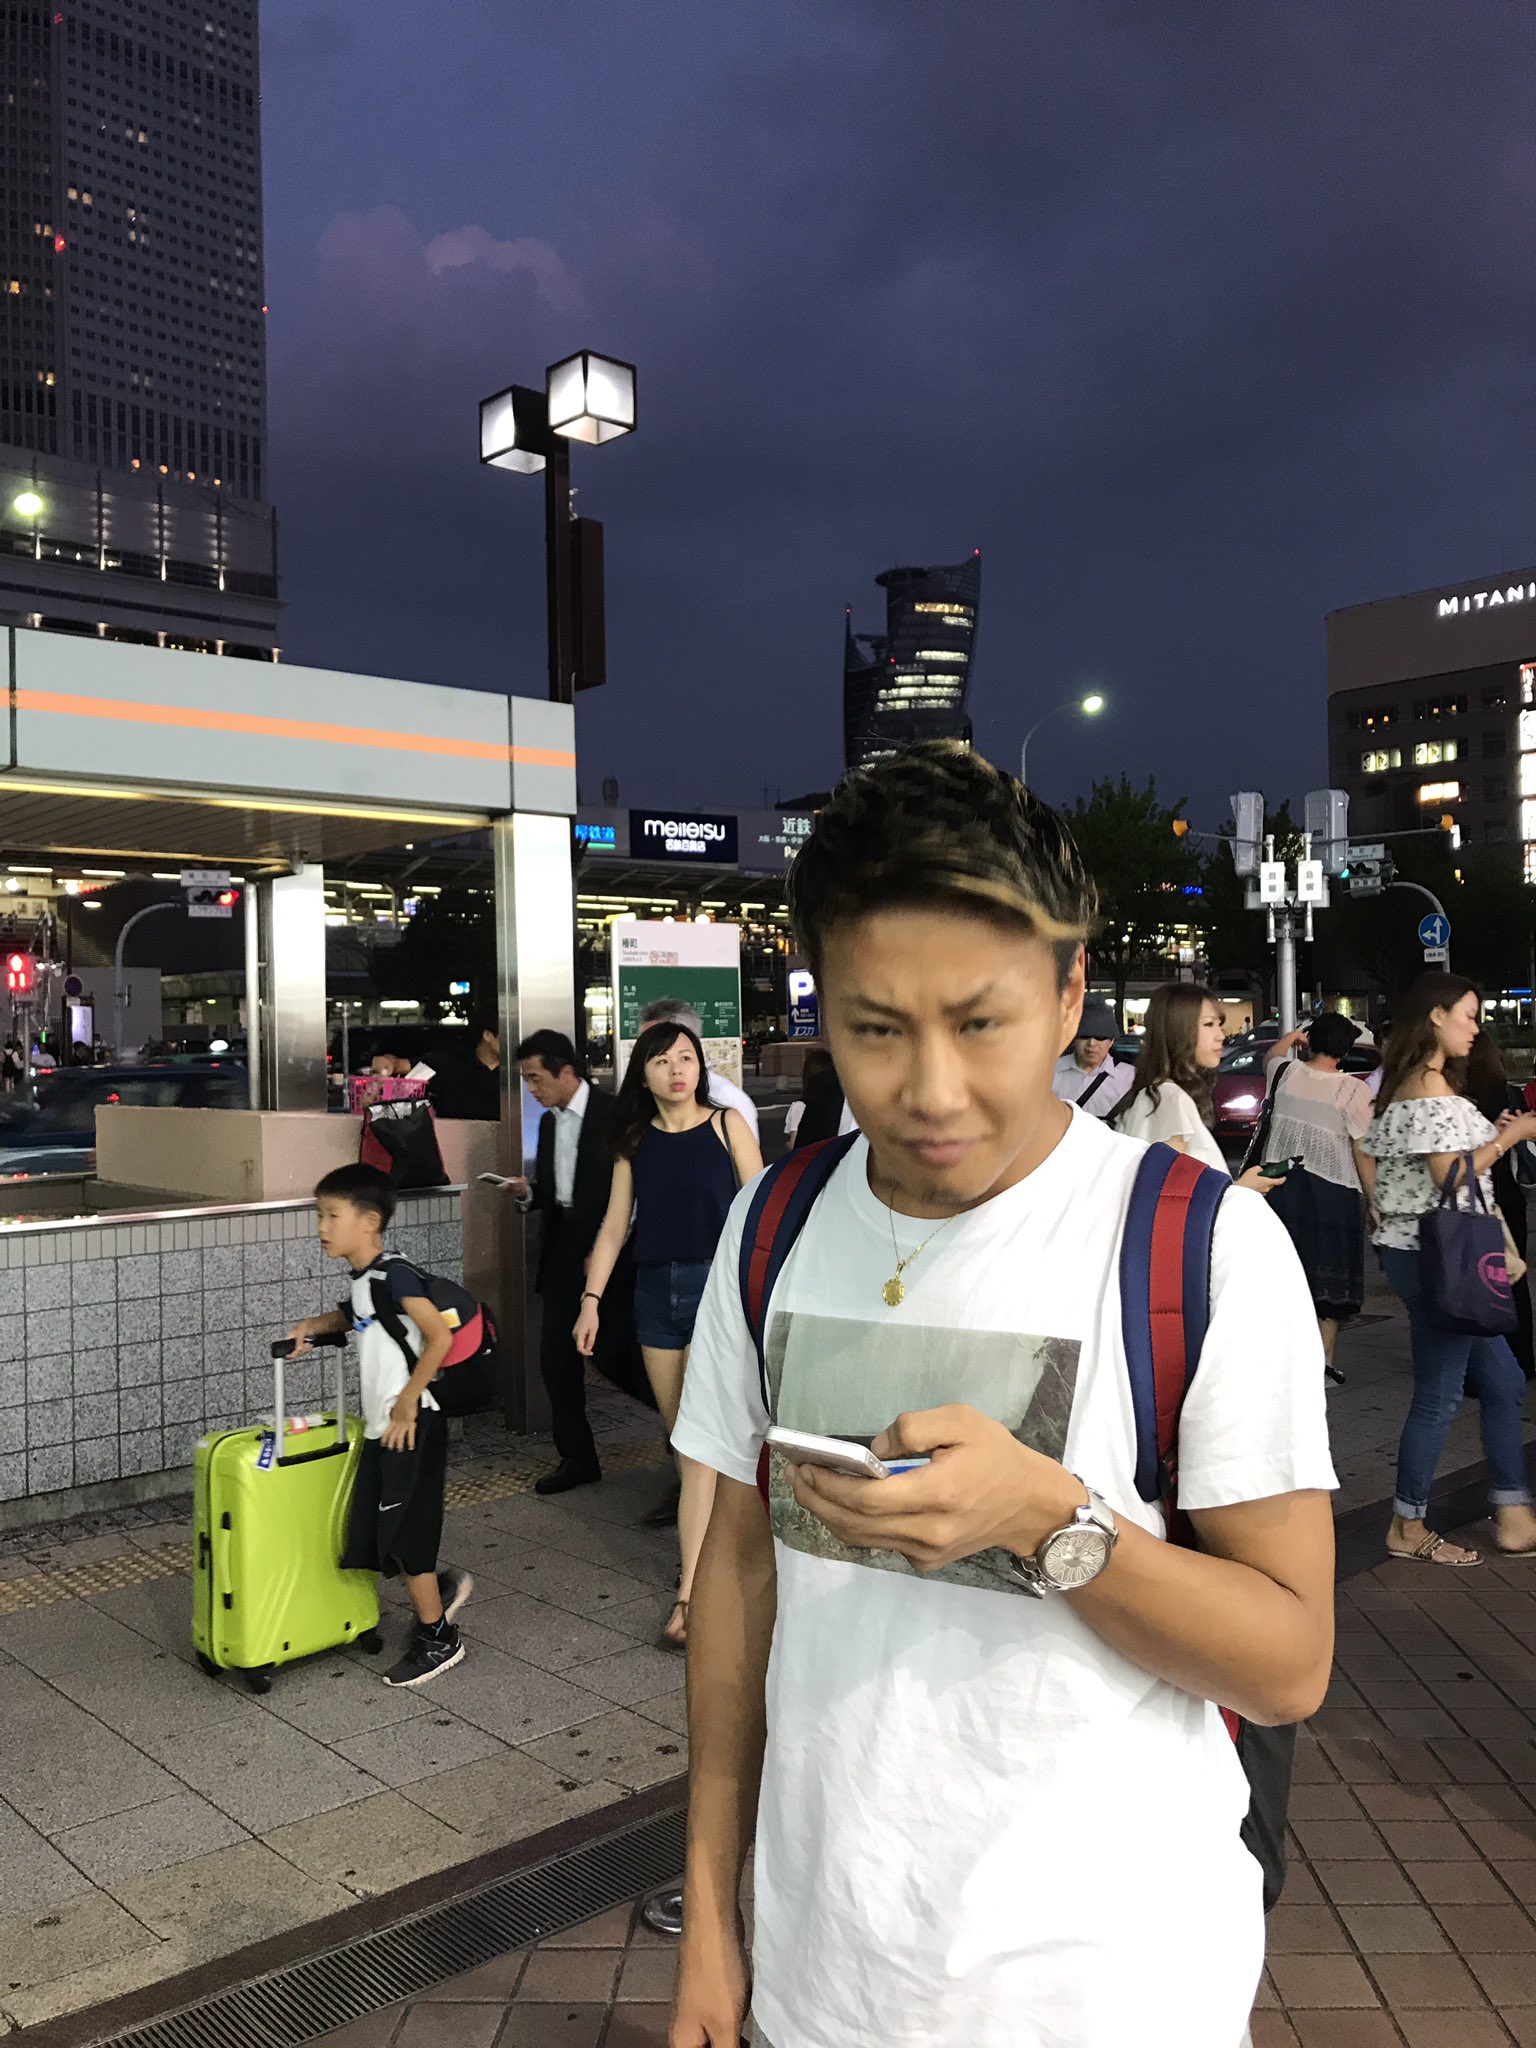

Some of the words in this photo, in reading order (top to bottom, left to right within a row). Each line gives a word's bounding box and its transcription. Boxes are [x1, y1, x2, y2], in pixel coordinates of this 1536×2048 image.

[1439, 582, 1536, 616] MITANI
[782, 817, 812, 834] 近鉄
[789, 971, 815, 1005] P
[793, 1026, 815, 1037] エスカ
